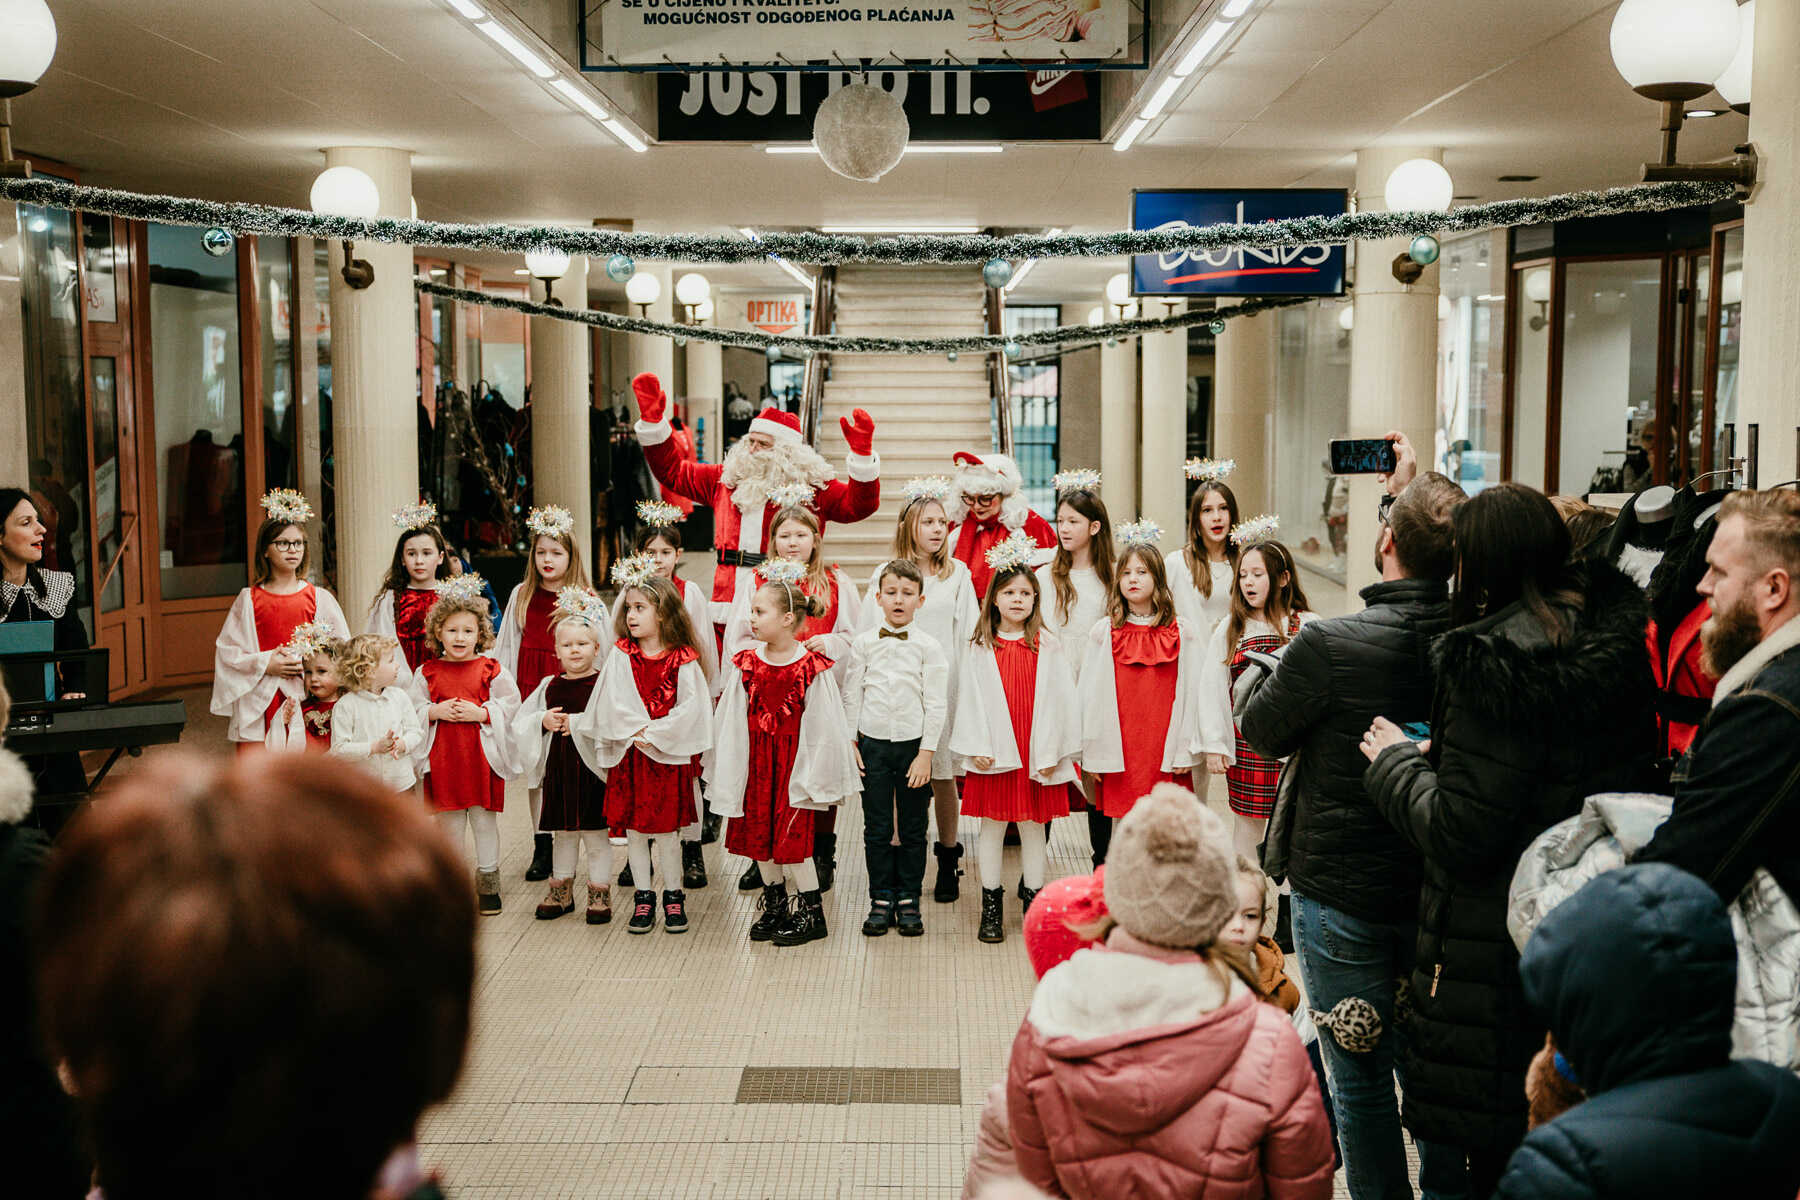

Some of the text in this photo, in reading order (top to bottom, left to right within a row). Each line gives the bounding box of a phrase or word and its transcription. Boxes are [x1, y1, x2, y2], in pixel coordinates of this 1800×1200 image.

[622, 0, 643, 8] SE
[648, 0, 660, 8] U
[665, 0, 727, 8] CIJENU
[643, 7, 955, 25] MOGUĆNOST ODGOĐENOG PLAĆANJA
[679, 61, 808, 116] JUST
[747, 300, 799, 322] OPTIKA
